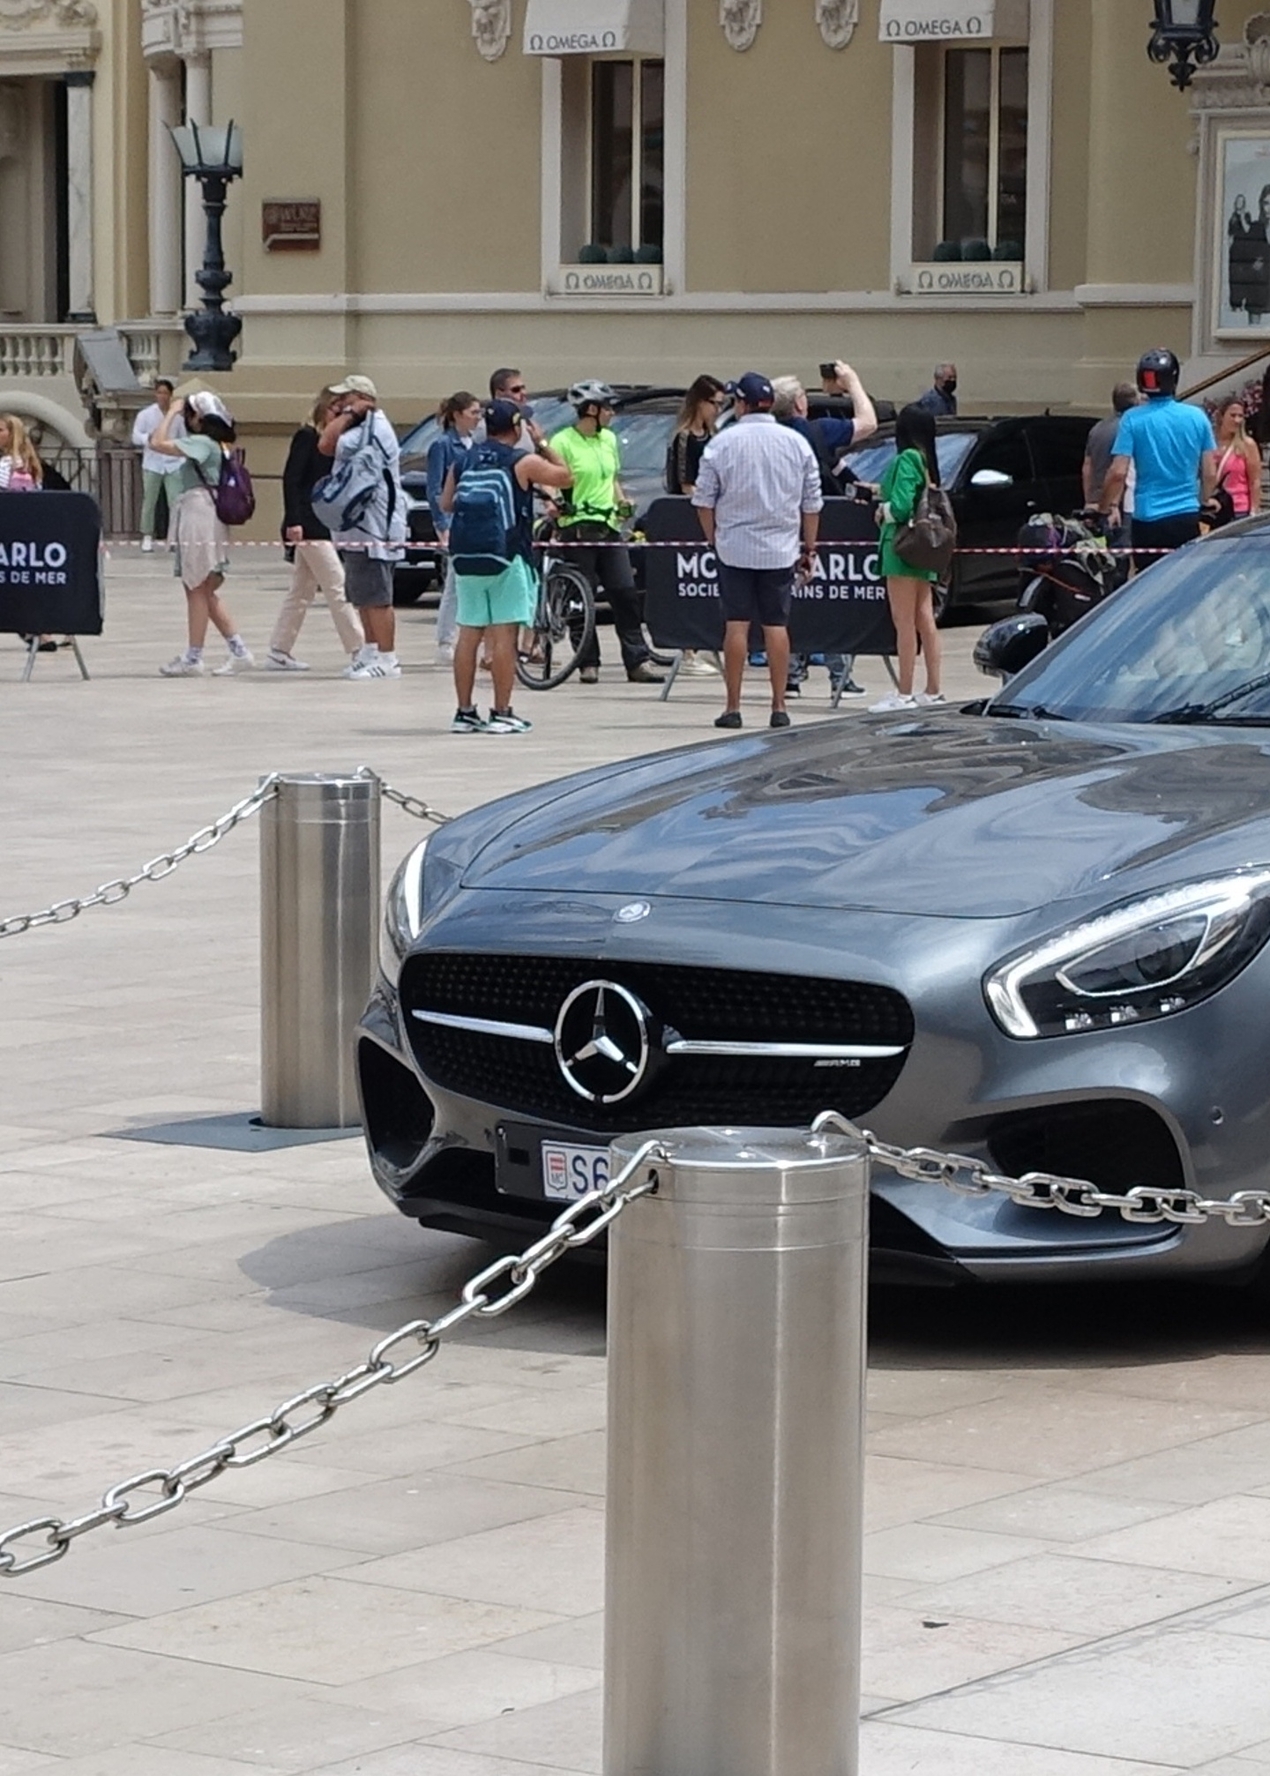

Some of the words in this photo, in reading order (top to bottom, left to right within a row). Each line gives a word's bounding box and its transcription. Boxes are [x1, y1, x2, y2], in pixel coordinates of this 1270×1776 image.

[904, 20, 963, 36] OMEGA
[546, 33, 599, 50] OMEGA
[938, 272, 993, 288] OMEGA
[0, 541, 66, 568] ARLO
[810, 553, 881, 582] ARLO
[10, 570, 30, 584] DE
[35, 571, 66, 585] MER
[829, 585, 849, 599] DE
[854, 586, 886, 600] MER
[572, 1155, 609, 1194] S6
